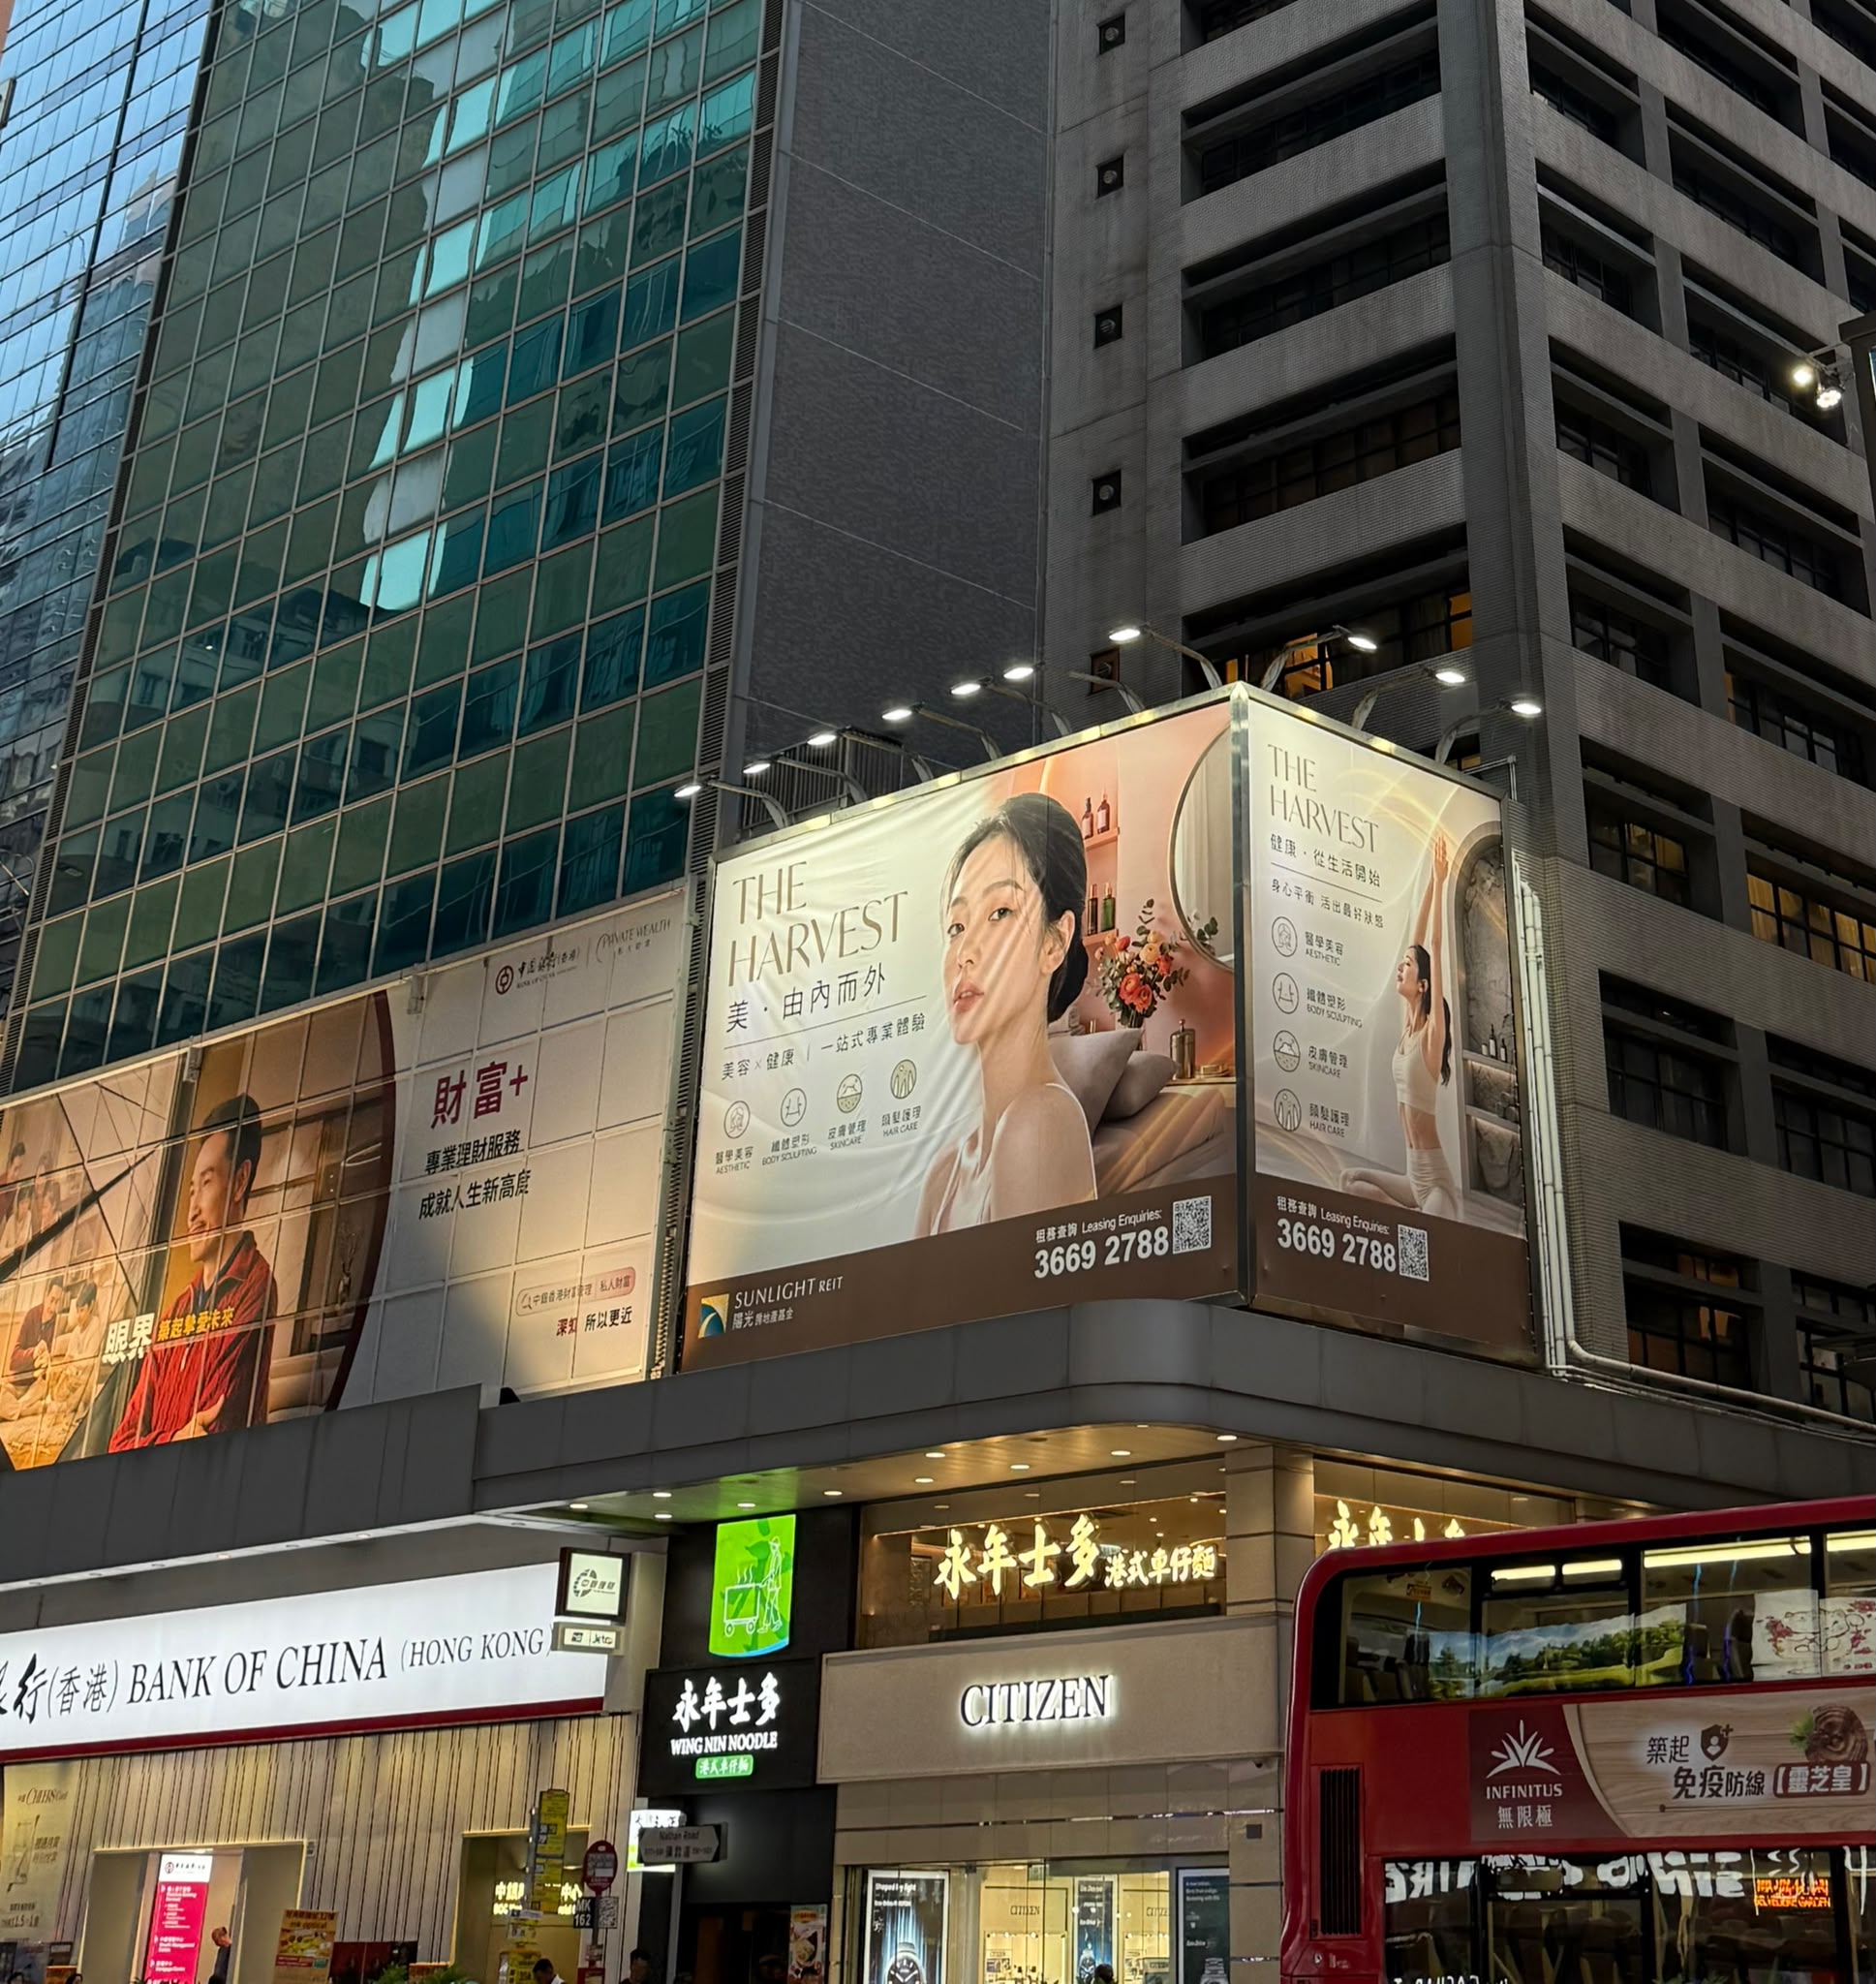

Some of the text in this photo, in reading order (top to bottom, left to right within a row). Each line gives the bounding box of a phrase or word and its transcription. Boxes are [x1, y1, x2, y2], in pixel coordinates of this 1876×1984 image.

[1268, 744, 1317, 792] THE
[1270, 784, 1379, 852] HARVEST
[733, 861, 807, 924] THE
[728, 891, 908, 987] HARVEST
[424, 1129, 521, 1174] 專業理財服務
[418, 1168, 531, 1220] 成就人生新高度
[1082, 1217, 1116, 1233] Leasing
[1119, 1209, 1163, 1226] Enquiries:
[1320, 1208, 1351, 1228] Leasing
[1353, 1216, 1390, 1235] Enquiries:
[1034, 1225, 1169, 1278] 3669 2788
[1277, 1218, 1397, 1272] 3669 2788
[734, 1276, 844, 1310] SUNLIGHT REIT
[584, 1306, 632, 1332] 所以更近
[934, 1513, 1101, 1599] 永年士多
[127, 1656, 217, 1704] BANK
[225, 1650, 267, 1694] OF
[276, 1636, 387, 1690] CHINA
[401, 1636, 473, 1672] (HONG
[480, 1623, 554, 1659] KONG)
[672, 1671, 781, 1732] 永年士多
[960, 1675, 1109, 1727] CITIZEN
[670, 1731, 778, 1756] WING NIN NOODLE
[1646, 1735, 1689, 1764] 築起
[1486, 1783, 1563, 1799] INFINITUS
[1673, 1765, 1766, 1799] 免疫防線
[683, 1830, 699, 1840] Road
[1497, 1804, 1553, 1829] 無限極
[574, 1913, 592, 1927] 162
[575, 1899, 592, 1912] MK
